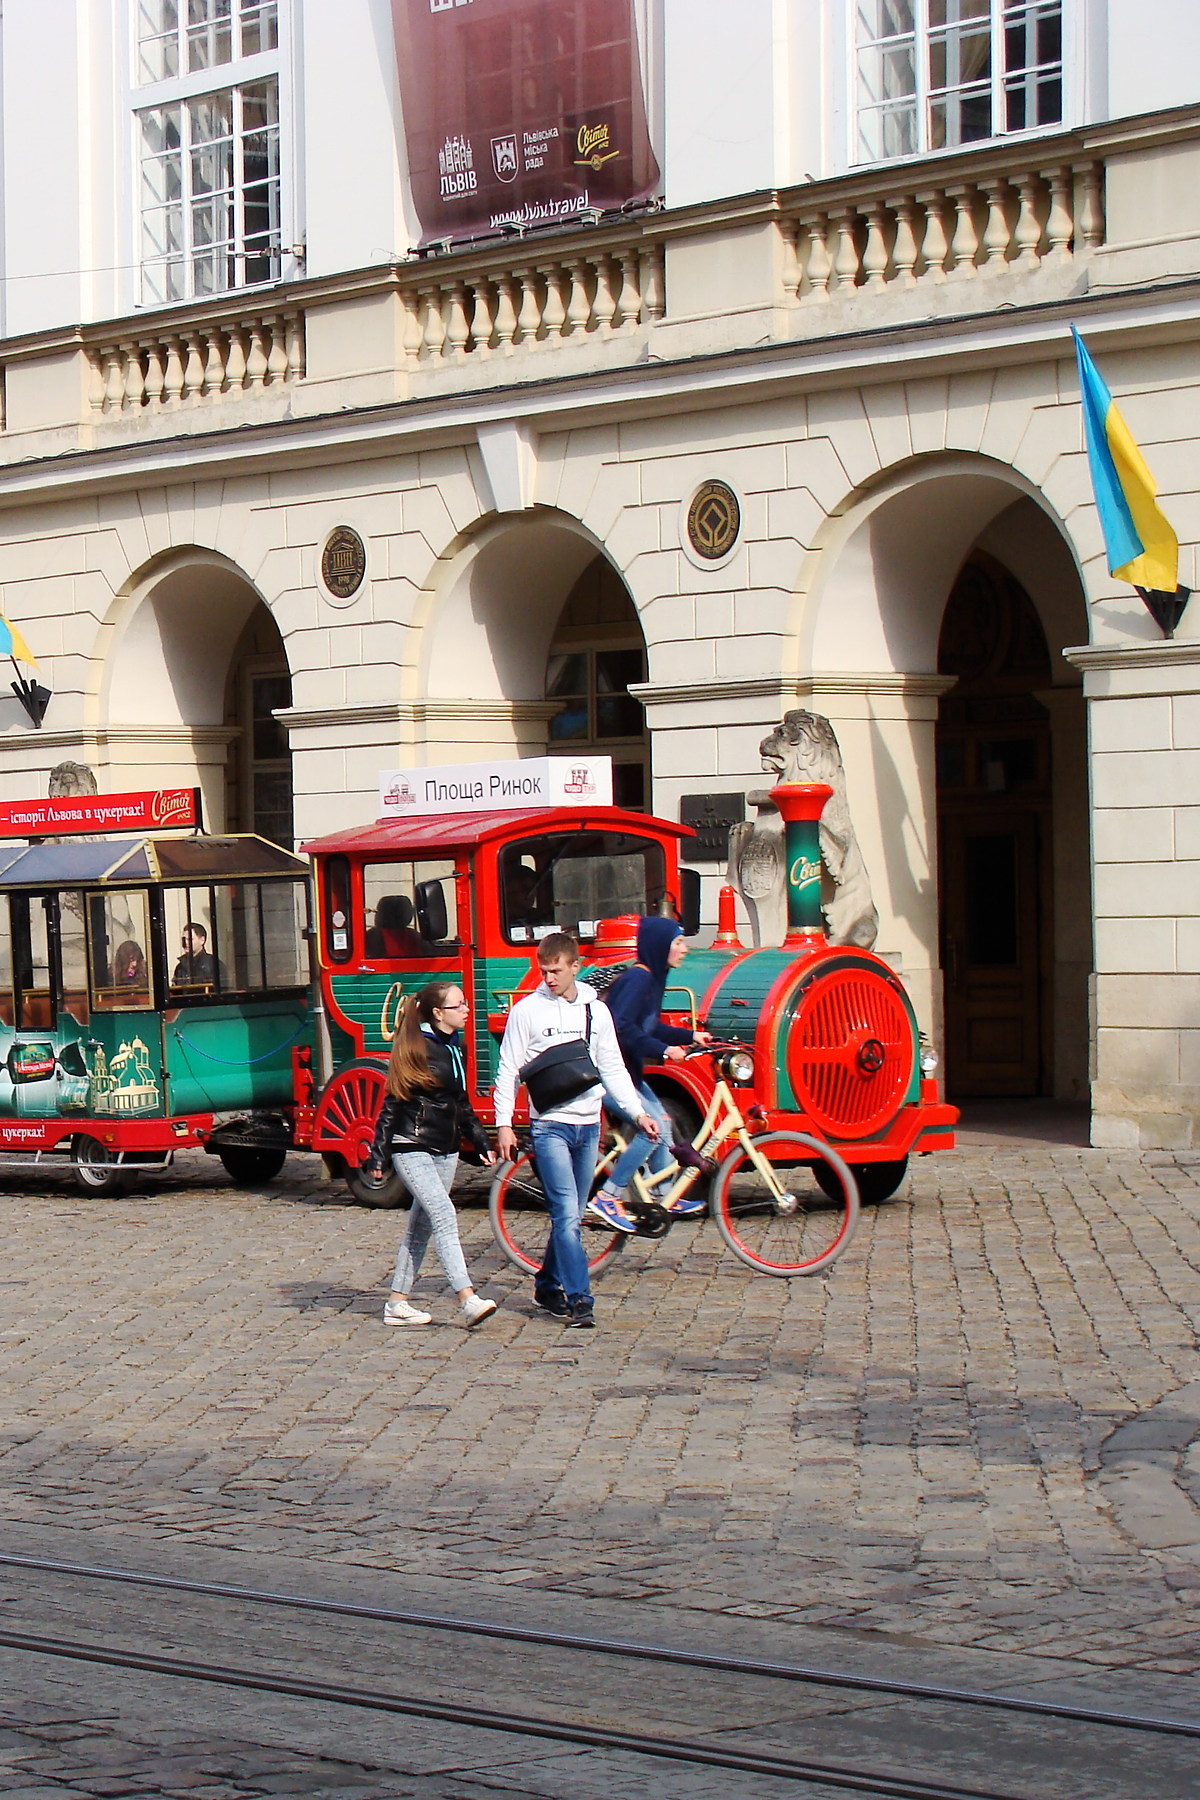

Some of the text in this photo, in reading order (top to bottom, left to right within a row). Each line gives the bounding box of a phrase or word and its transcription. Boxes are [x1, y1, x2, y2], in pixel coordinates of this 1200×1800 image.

[523, 127, 559, 144] Львівська
[524, 143, 548, 157] міська
[525, 156, 544, 171] рада
[440, 170, 478, 196] ЛЬВІВ
[489, 189, 589, 229] www.lviv.travel
[425, 774, 542, 803] Площа Ринок
[10, 808, 45, 827] історії
[47, 807, 84, 822] Львова
[85, 809, 92, 819] в
[93, 801, 145, 823] цукерках!
[151, 790, 191, 822] Світоч
[2, 1125, 45, 1141] цукерках!
